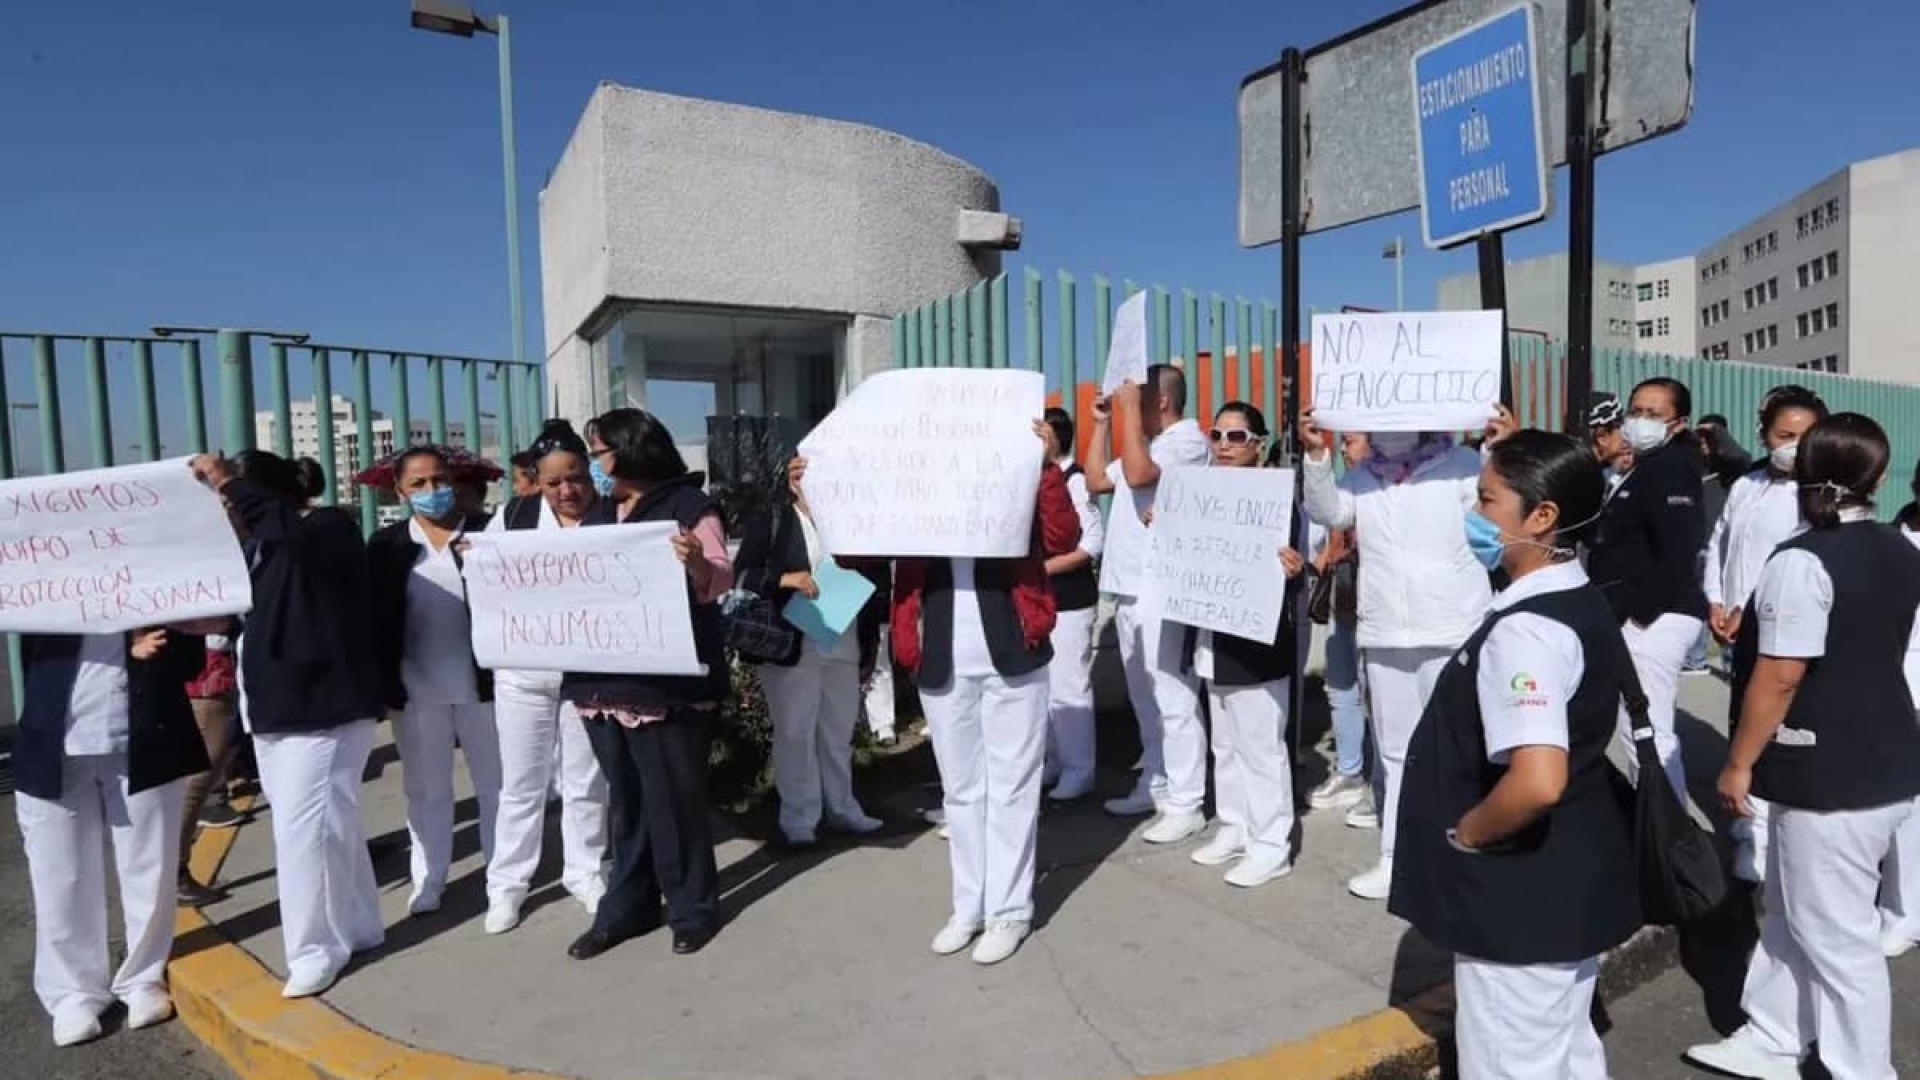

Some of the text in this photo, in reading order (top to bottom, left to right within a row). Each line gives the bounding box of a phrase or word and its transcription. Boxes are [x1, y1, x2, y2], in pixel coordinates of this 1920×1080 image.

[1420, 41, 1525, 118] ESTACIONAMIENTO
[1459, 114, 1491, 154] PARA
[1449, 160, 1511, 214] PERSONAL
[1321, 319, 1442, 365] NO AL
[1314, 367, 1499, 411] GENOCIDIO
[948, 452, 962, 474] A
[975, 450, 1005, 476] LA
[0, 534, 70, 564] UIPO
[79, 575, 226, 624] PERSONAL
